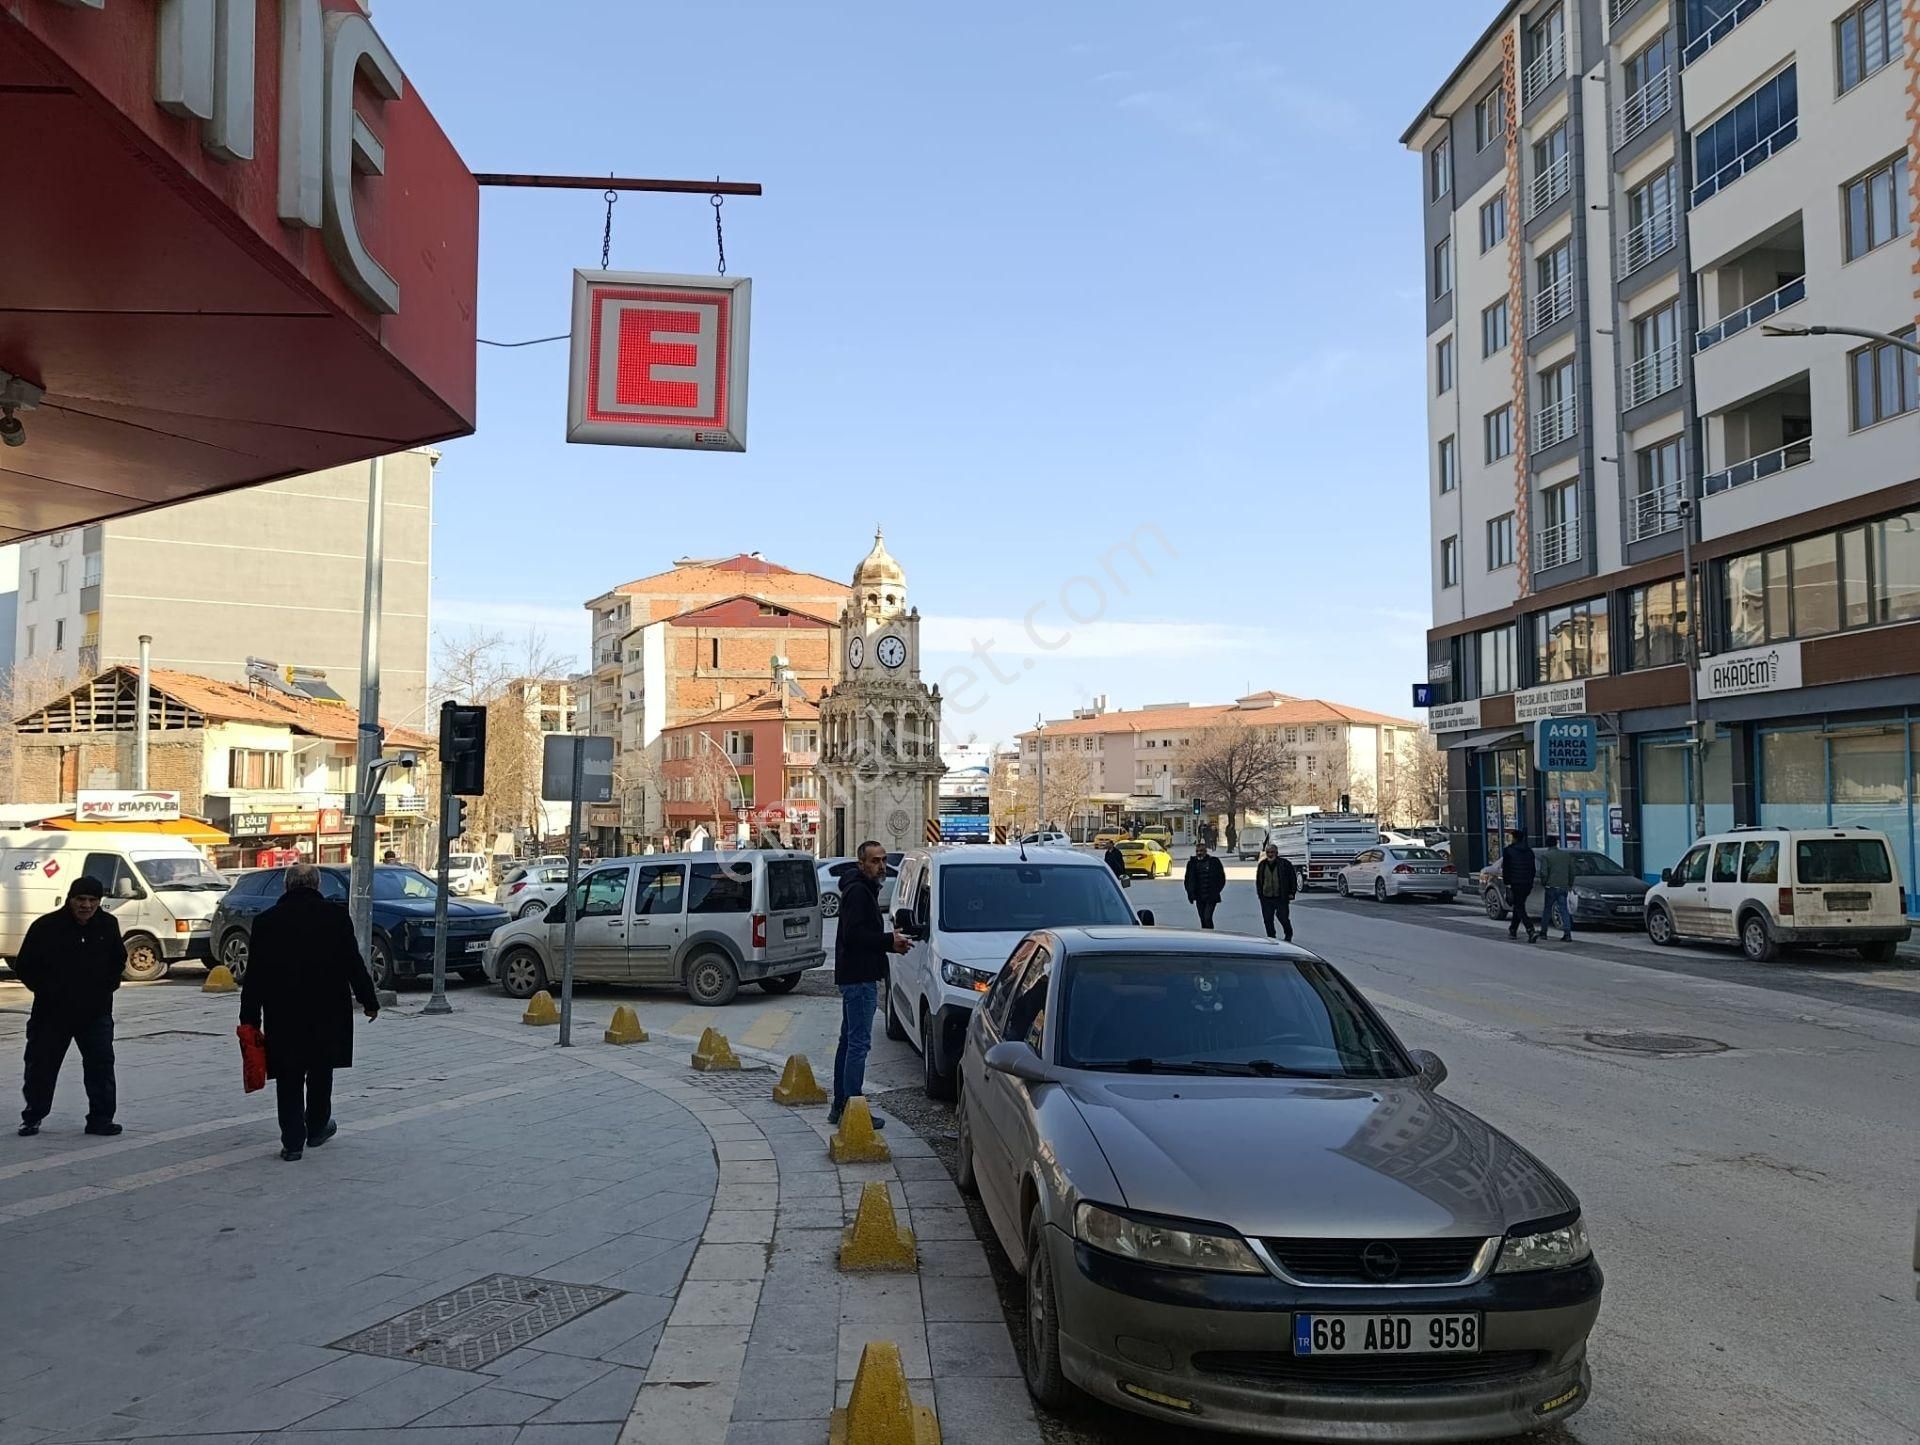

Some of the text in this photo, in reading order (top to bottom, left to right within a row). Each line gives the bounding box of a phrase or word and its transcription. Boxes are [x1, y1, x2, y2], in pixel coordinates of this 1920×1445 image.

[617, 308, 700, 408] E
[1549, 740, 1587, 748] HARCA
[1549, 749, 1587, 757] HARCA
[14, 861, 40, 871] aras
[1299, 1317, 1476, 1351] TR 68 ABD 958
